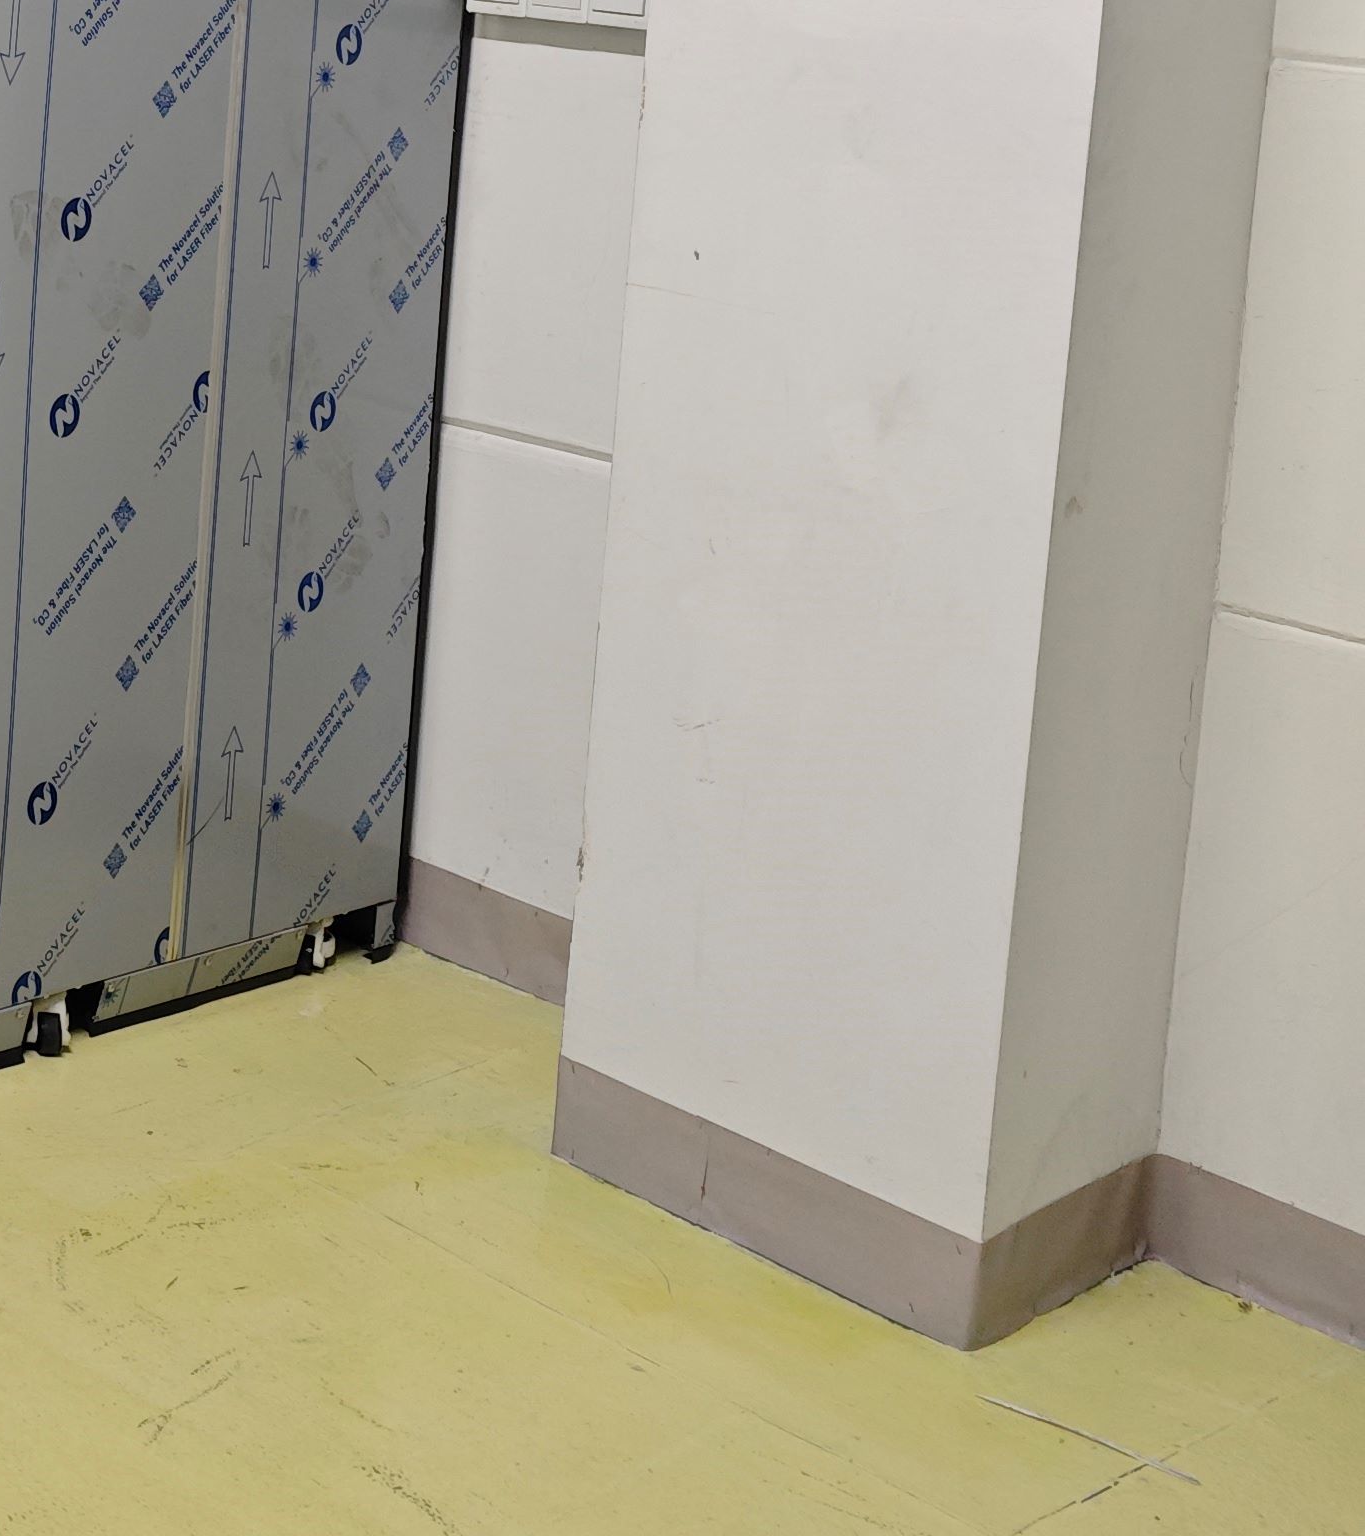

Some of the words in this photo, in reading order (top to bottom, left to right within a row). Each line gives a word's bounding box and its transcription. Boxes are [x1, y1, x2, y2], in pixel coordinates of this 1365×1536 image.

[86, 141, 134, 202] NOVACEL
[74, 336, 121, 397] NOVACEL
[331, 337, 373, 400] NOVACEL
[153, 412, 199, 470] NOVACEL
[73, 538, 98, 574] LASER
[97, 523, 109, 540] for
[101, 536, 117, 555] The
[318, 516, 359, 580] NOVACEL
[55, 572, 75, 600] Fiber
[74, 554, 104, 596] Novacel
[45, 594, 76, 636] Solution
[48, 599, 57, 609] &
[51, 720, 98, 784] NOVACEL
[37, 908, 85, 973] NOVACEL
